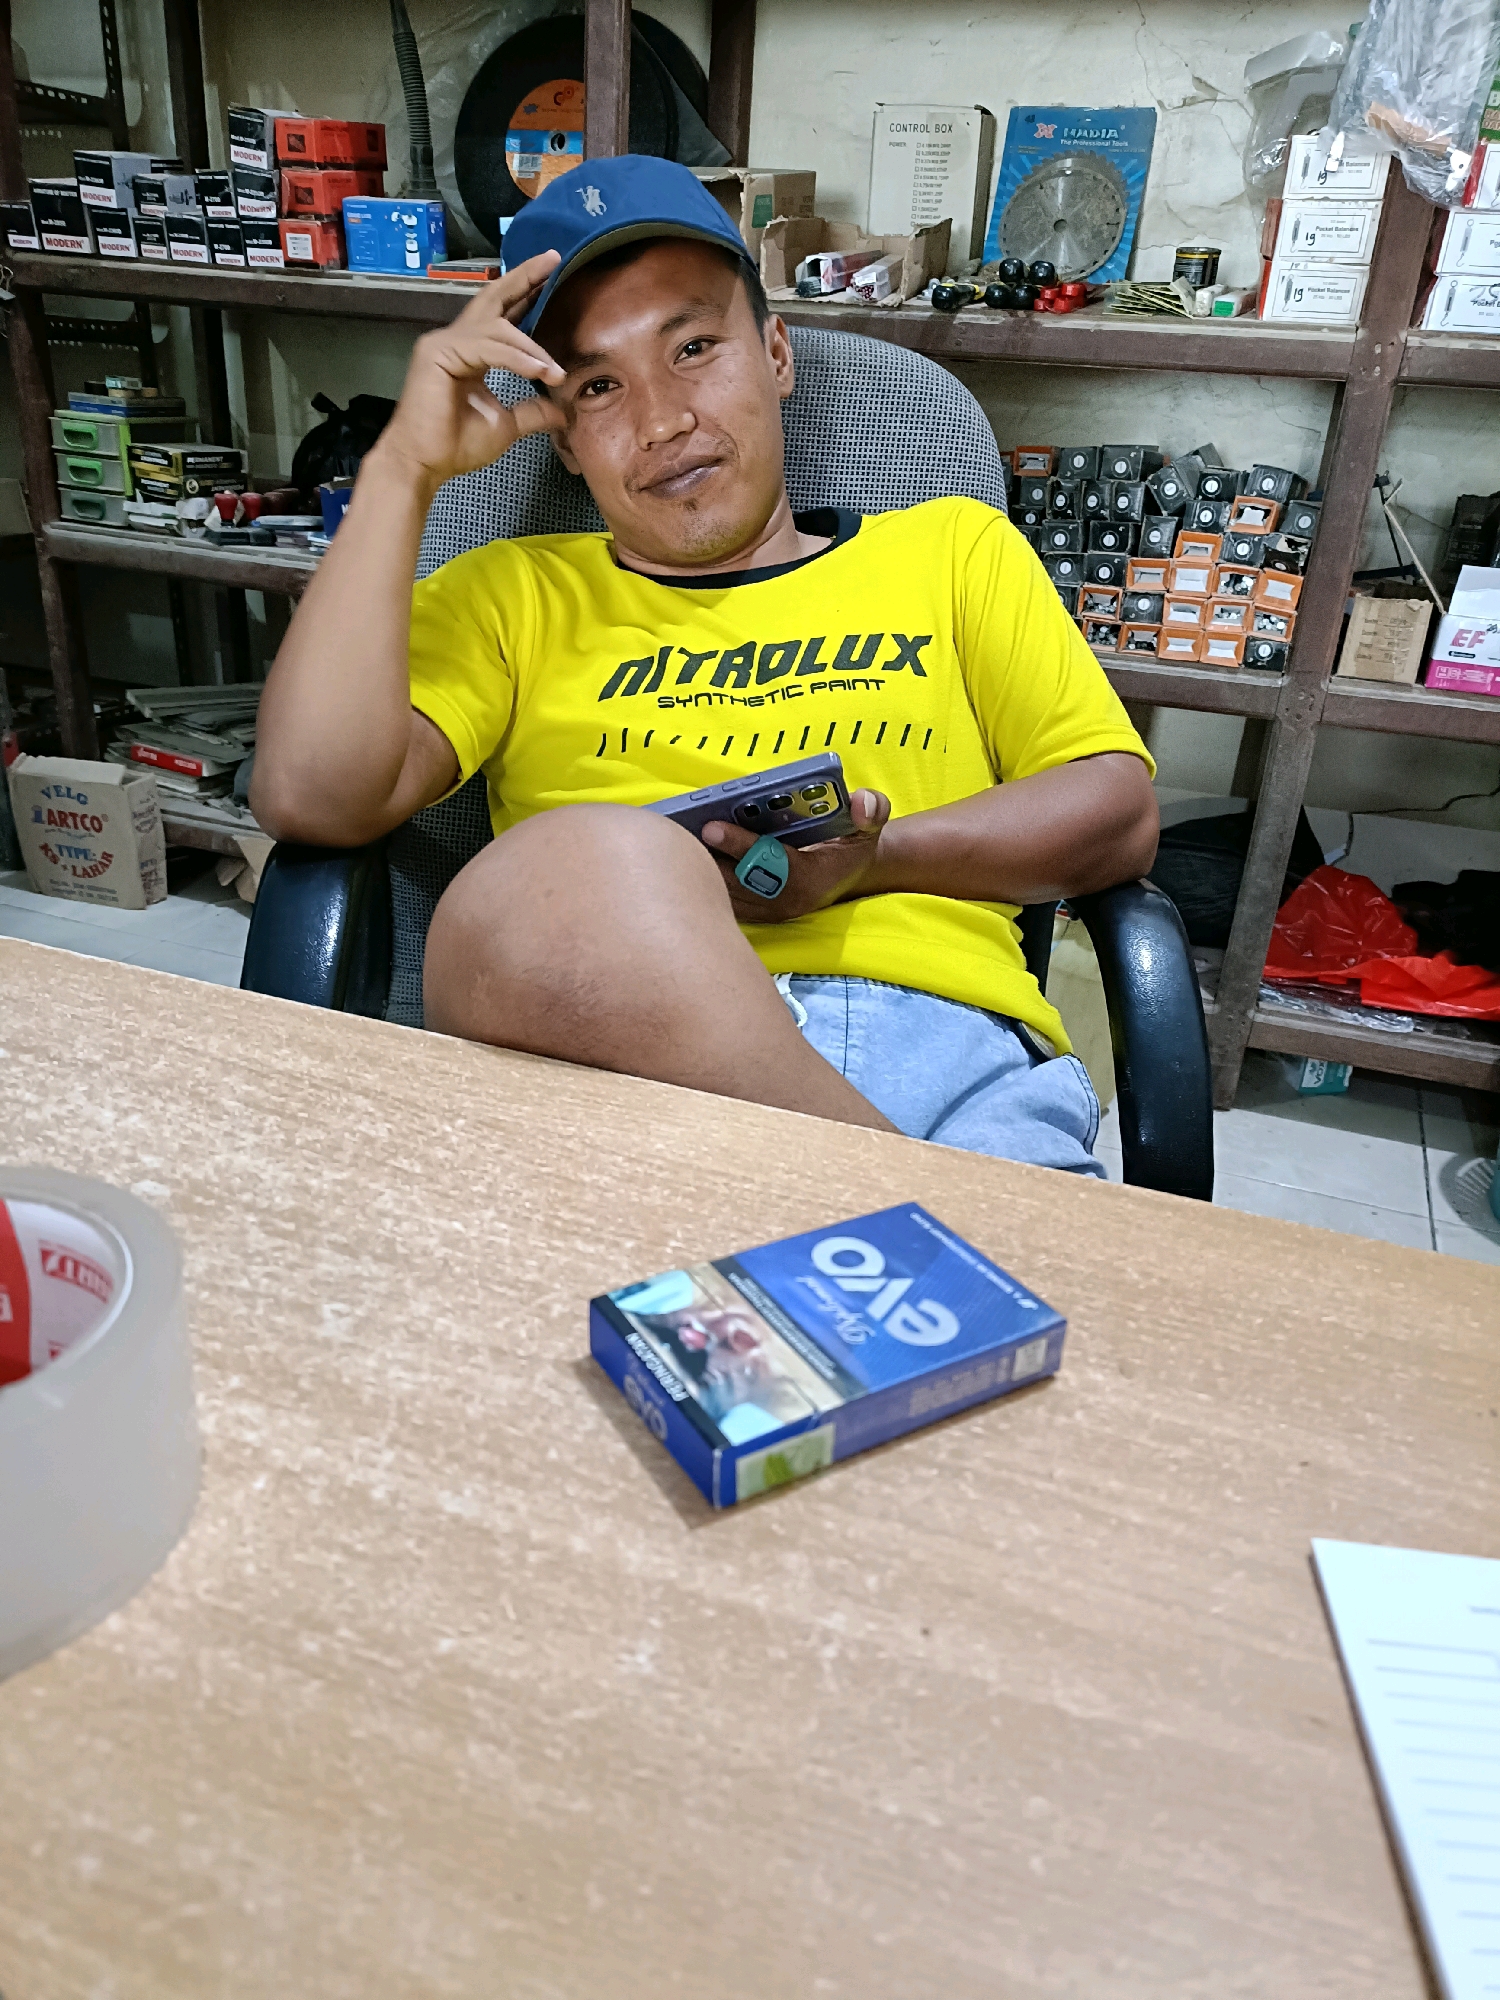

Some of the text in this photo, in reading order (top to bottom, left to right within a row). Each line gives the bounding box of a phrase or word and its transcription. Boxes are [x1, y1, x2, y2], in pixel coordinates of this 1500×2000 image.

[889, 123, 953, 133] CONTROL BOX
[233, 150, 262, 163] MODERN
[82, 191, 112, 203] MODERN
[45, 237, 83, 250] MODERN
[101, 242, 131, 252] MODERN
[172, 249, 203, 258] MODERN
[249, 254, 281, 264] MODERN
[1450, 628, 1487, 649] EF
[597, 633, 934, 702] NITROLUX
[657, 678, 886, 708] SYNTHETIC PAINT
[47, 808, 104, 834] ARTCO
[624, 1332, 689, 1403] PERINGATAN
